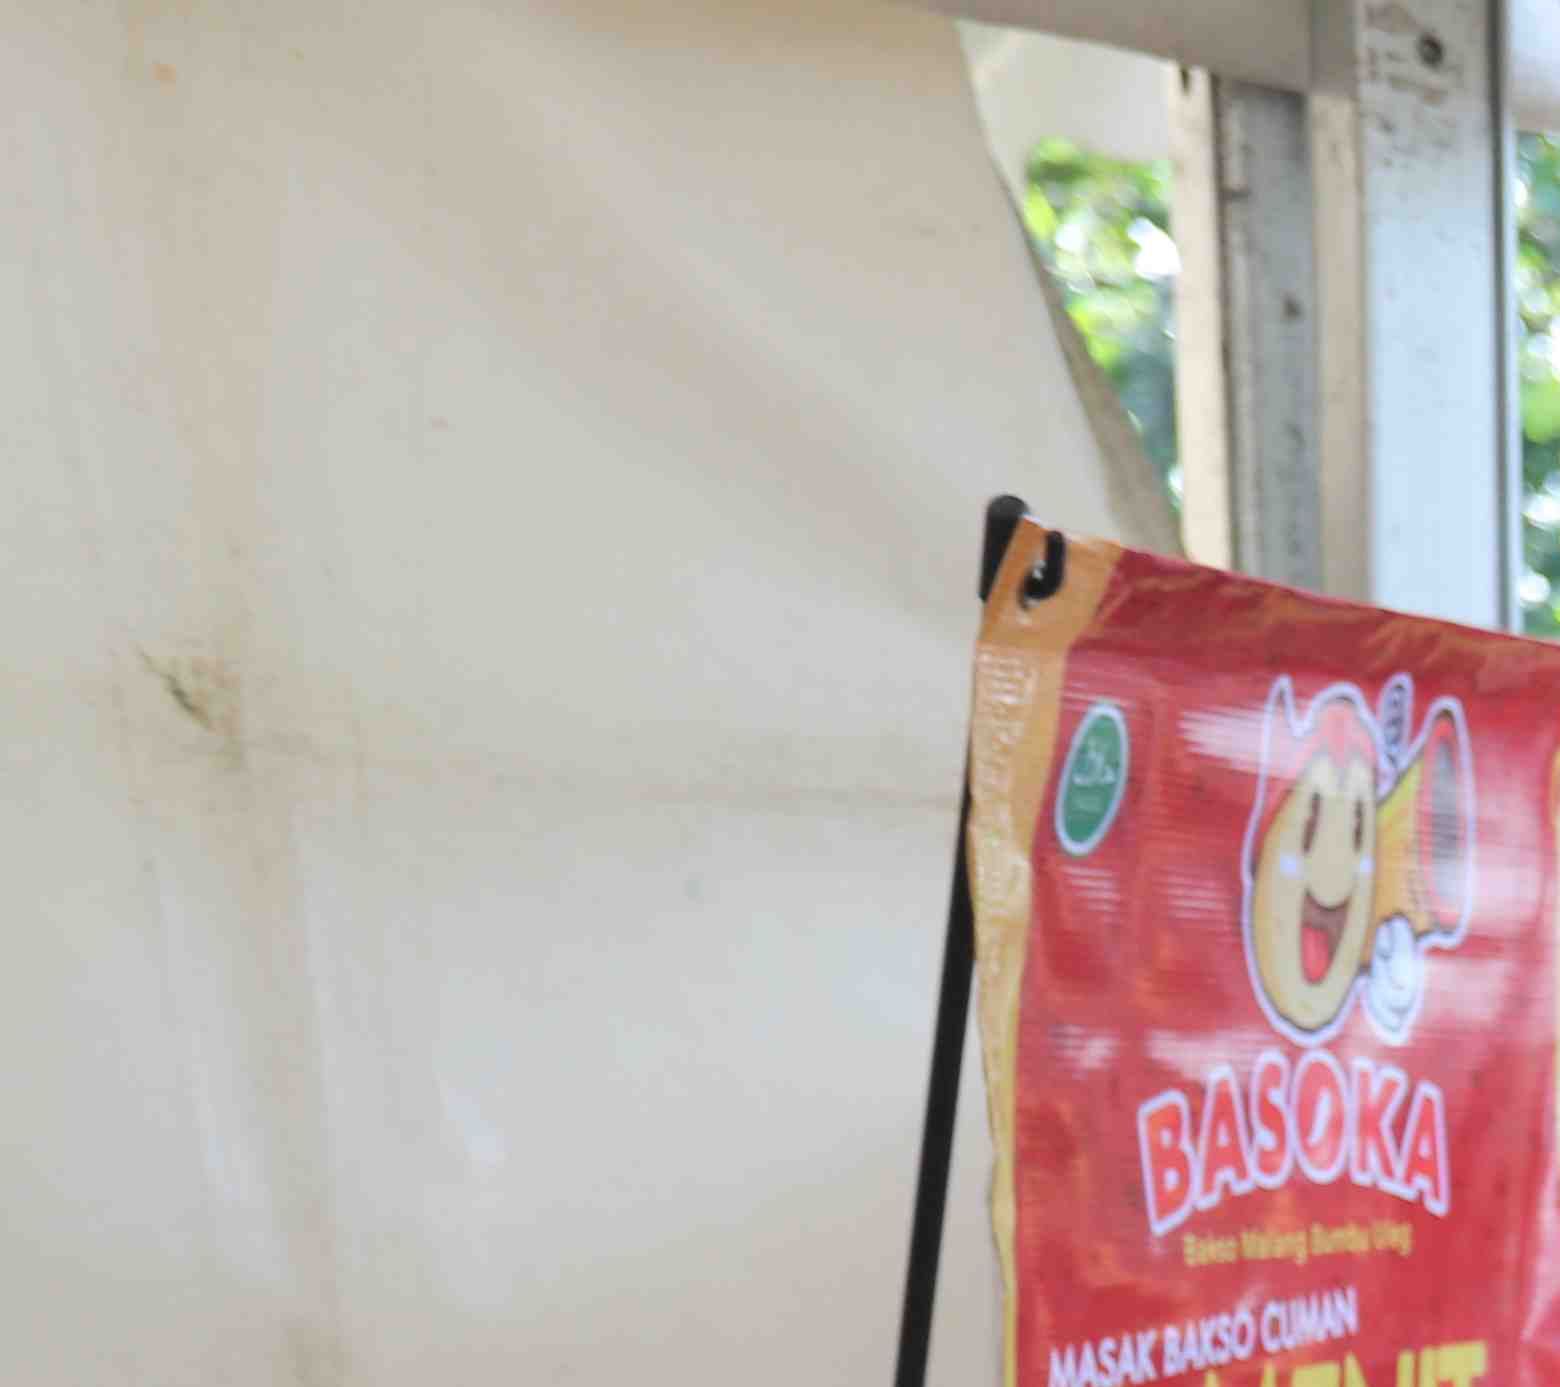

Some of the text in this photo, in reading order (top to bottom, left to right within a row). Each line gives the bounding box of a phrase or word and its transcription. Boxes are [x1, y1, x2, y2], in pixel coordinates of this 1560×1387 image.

[1136, 1049, 1451, 1238] BASOKA
[1162, 1310, 1257, 1376] BAKSO
[1260, 1284, 1360, 1354] CUMAN
